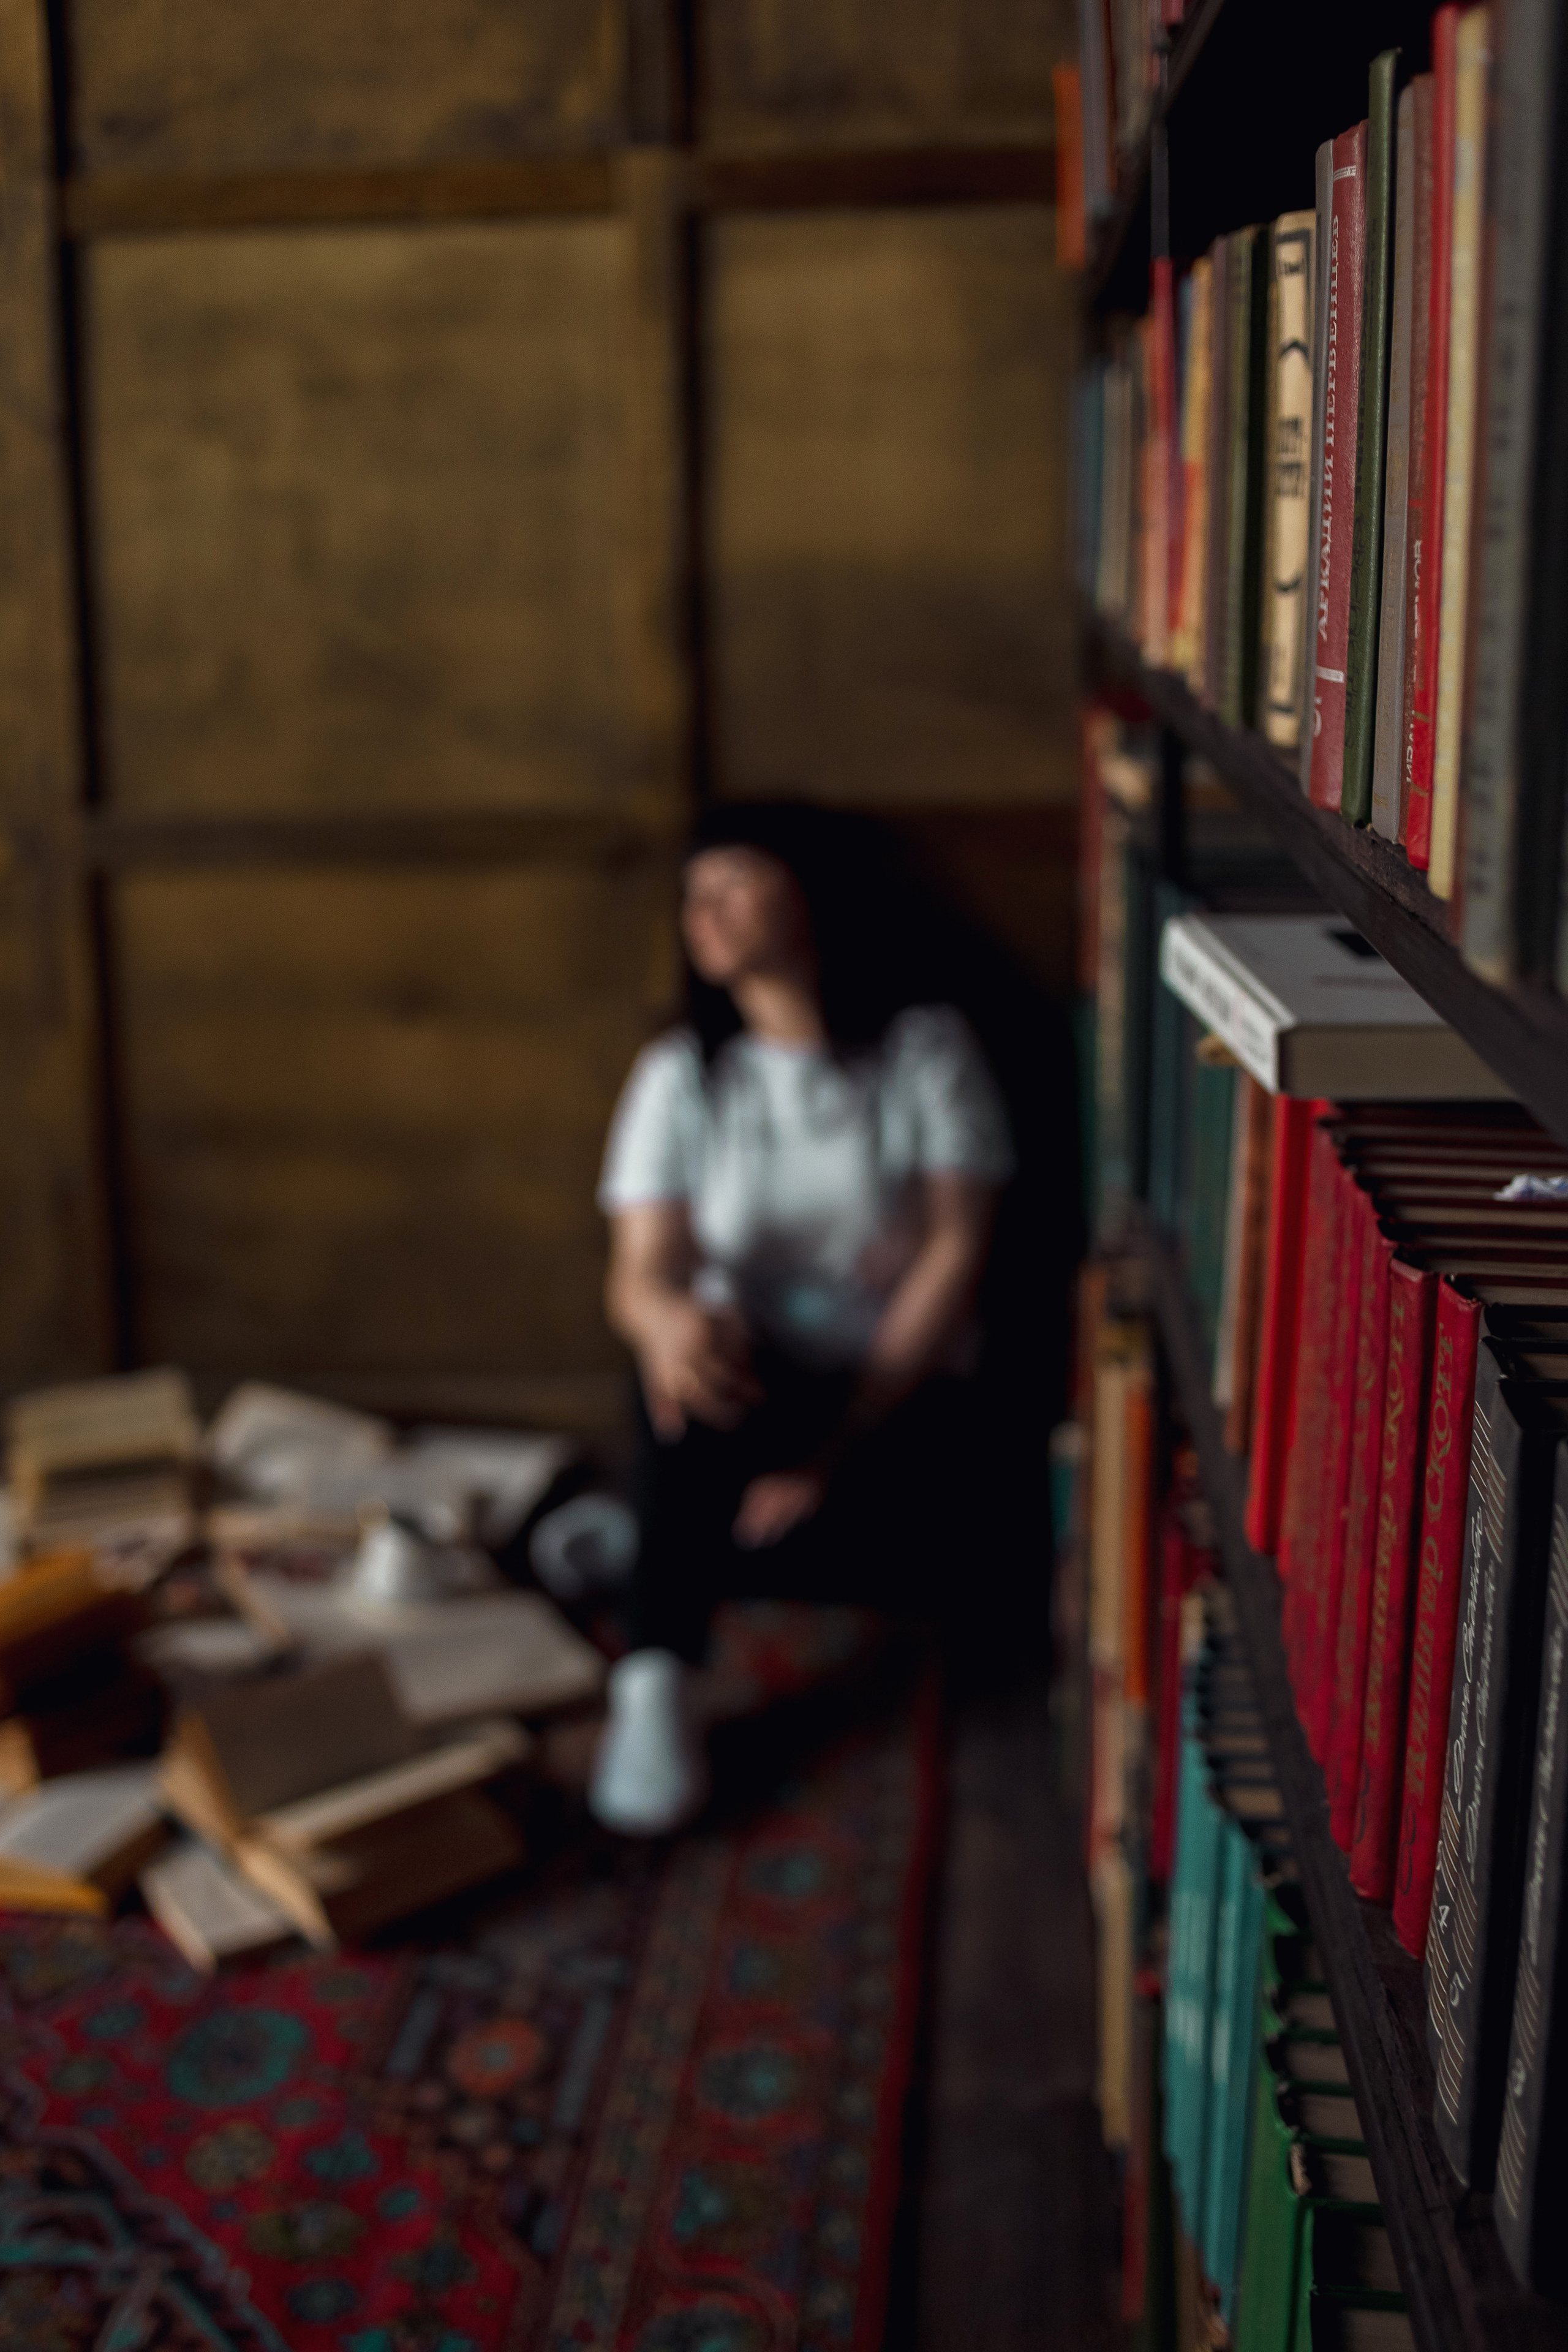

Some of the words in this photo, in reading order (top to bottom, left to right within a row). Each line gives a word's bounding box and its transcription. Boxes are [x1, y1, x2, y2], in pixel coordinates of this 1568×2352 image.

[1324, 214, 1339, 447] ПЕРВЕНЦЕВ
[1438, 1905, 1450, 1934] 4
[1449, 1971, 1464, 2007] 5
